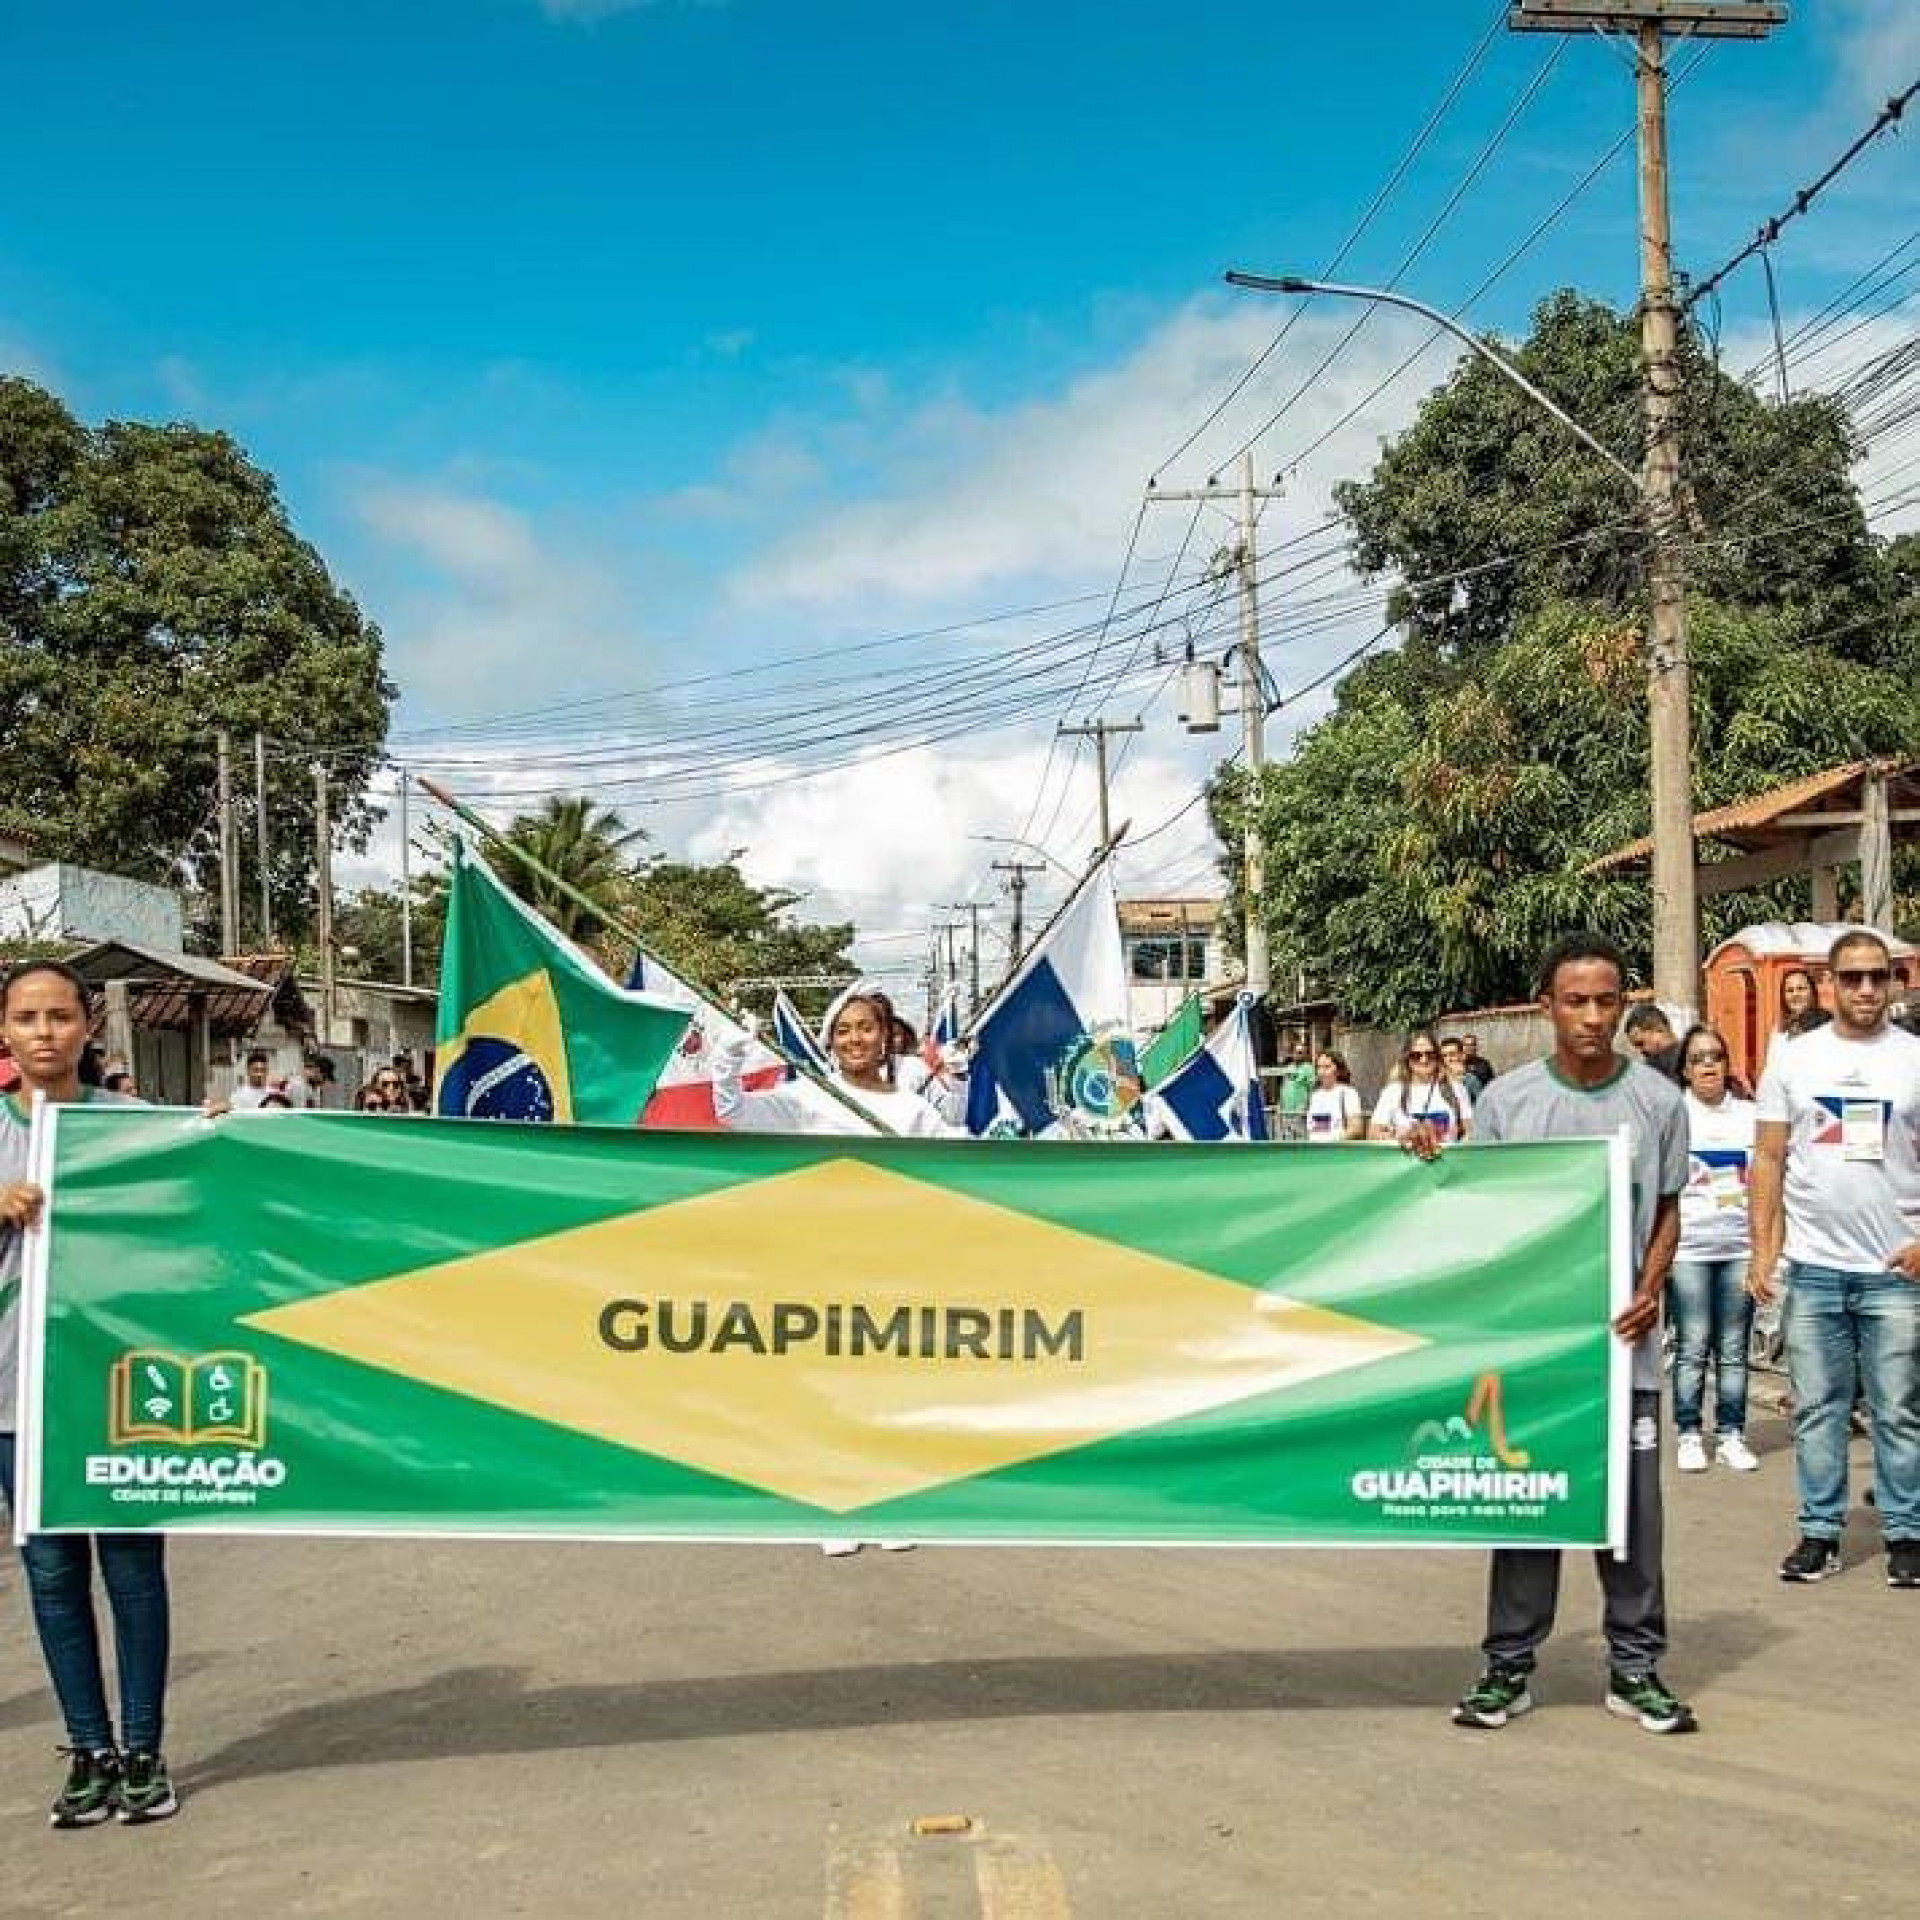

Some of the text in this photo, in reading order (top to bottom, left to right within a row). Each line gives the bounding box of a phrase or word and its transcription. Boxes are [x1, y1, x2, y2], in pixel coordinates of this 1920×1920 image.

[597, 1298, 1084, 1361] GUAPIMIRIM
[85, 1452, 286, 1489] EDUCAÇÃO
[1416, 1455, 1496, 1469] CIDADE DE
[1352, 1471, 1568, 1501] GUAPIMIRIM
